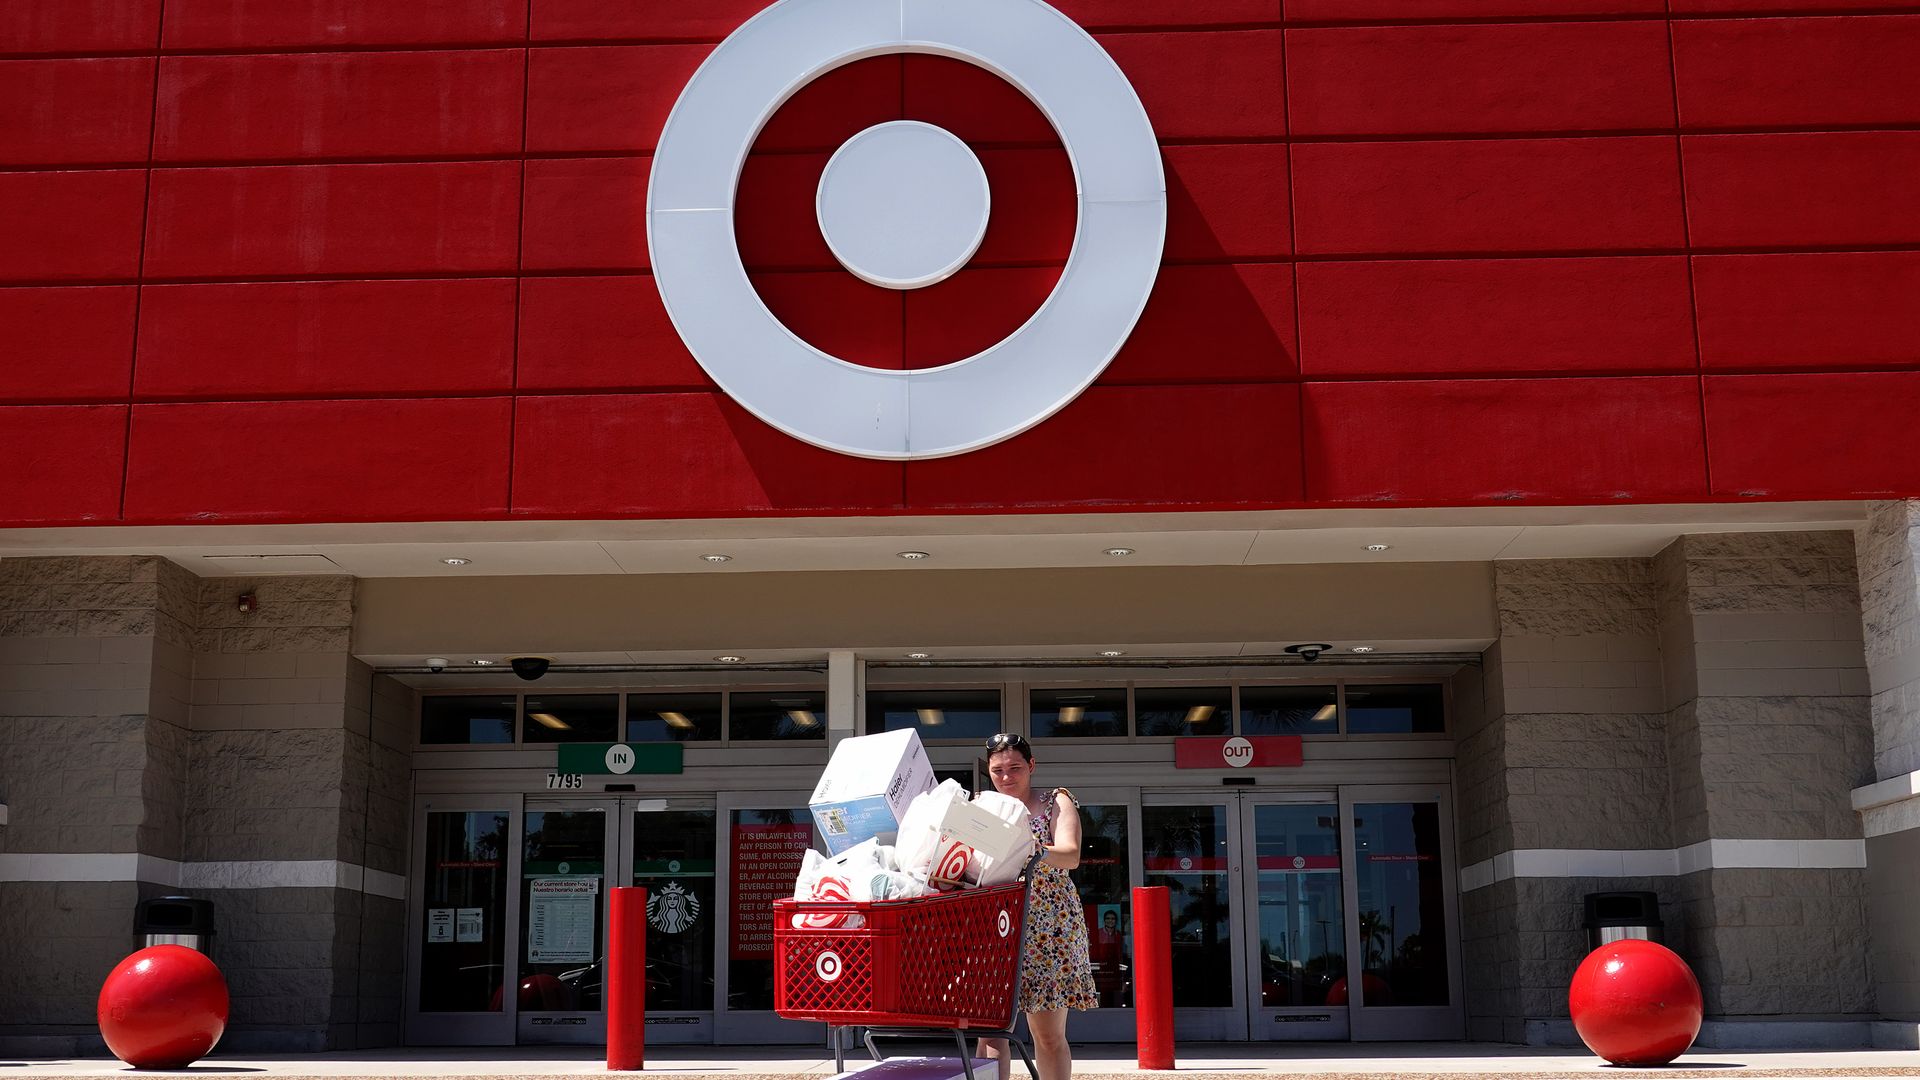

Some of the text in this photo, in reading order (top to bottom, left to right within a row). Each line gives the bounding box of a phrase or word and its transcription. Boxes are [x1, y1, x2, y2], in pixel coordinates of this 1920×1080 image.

[1223, 746, 1251, 757] OUT
[613, 753, 627, 764] IN
[549, 774, 582, 788] 7795
[889, 773, 903, 801] Haier
[739, 853, 761, 861] SUME,
